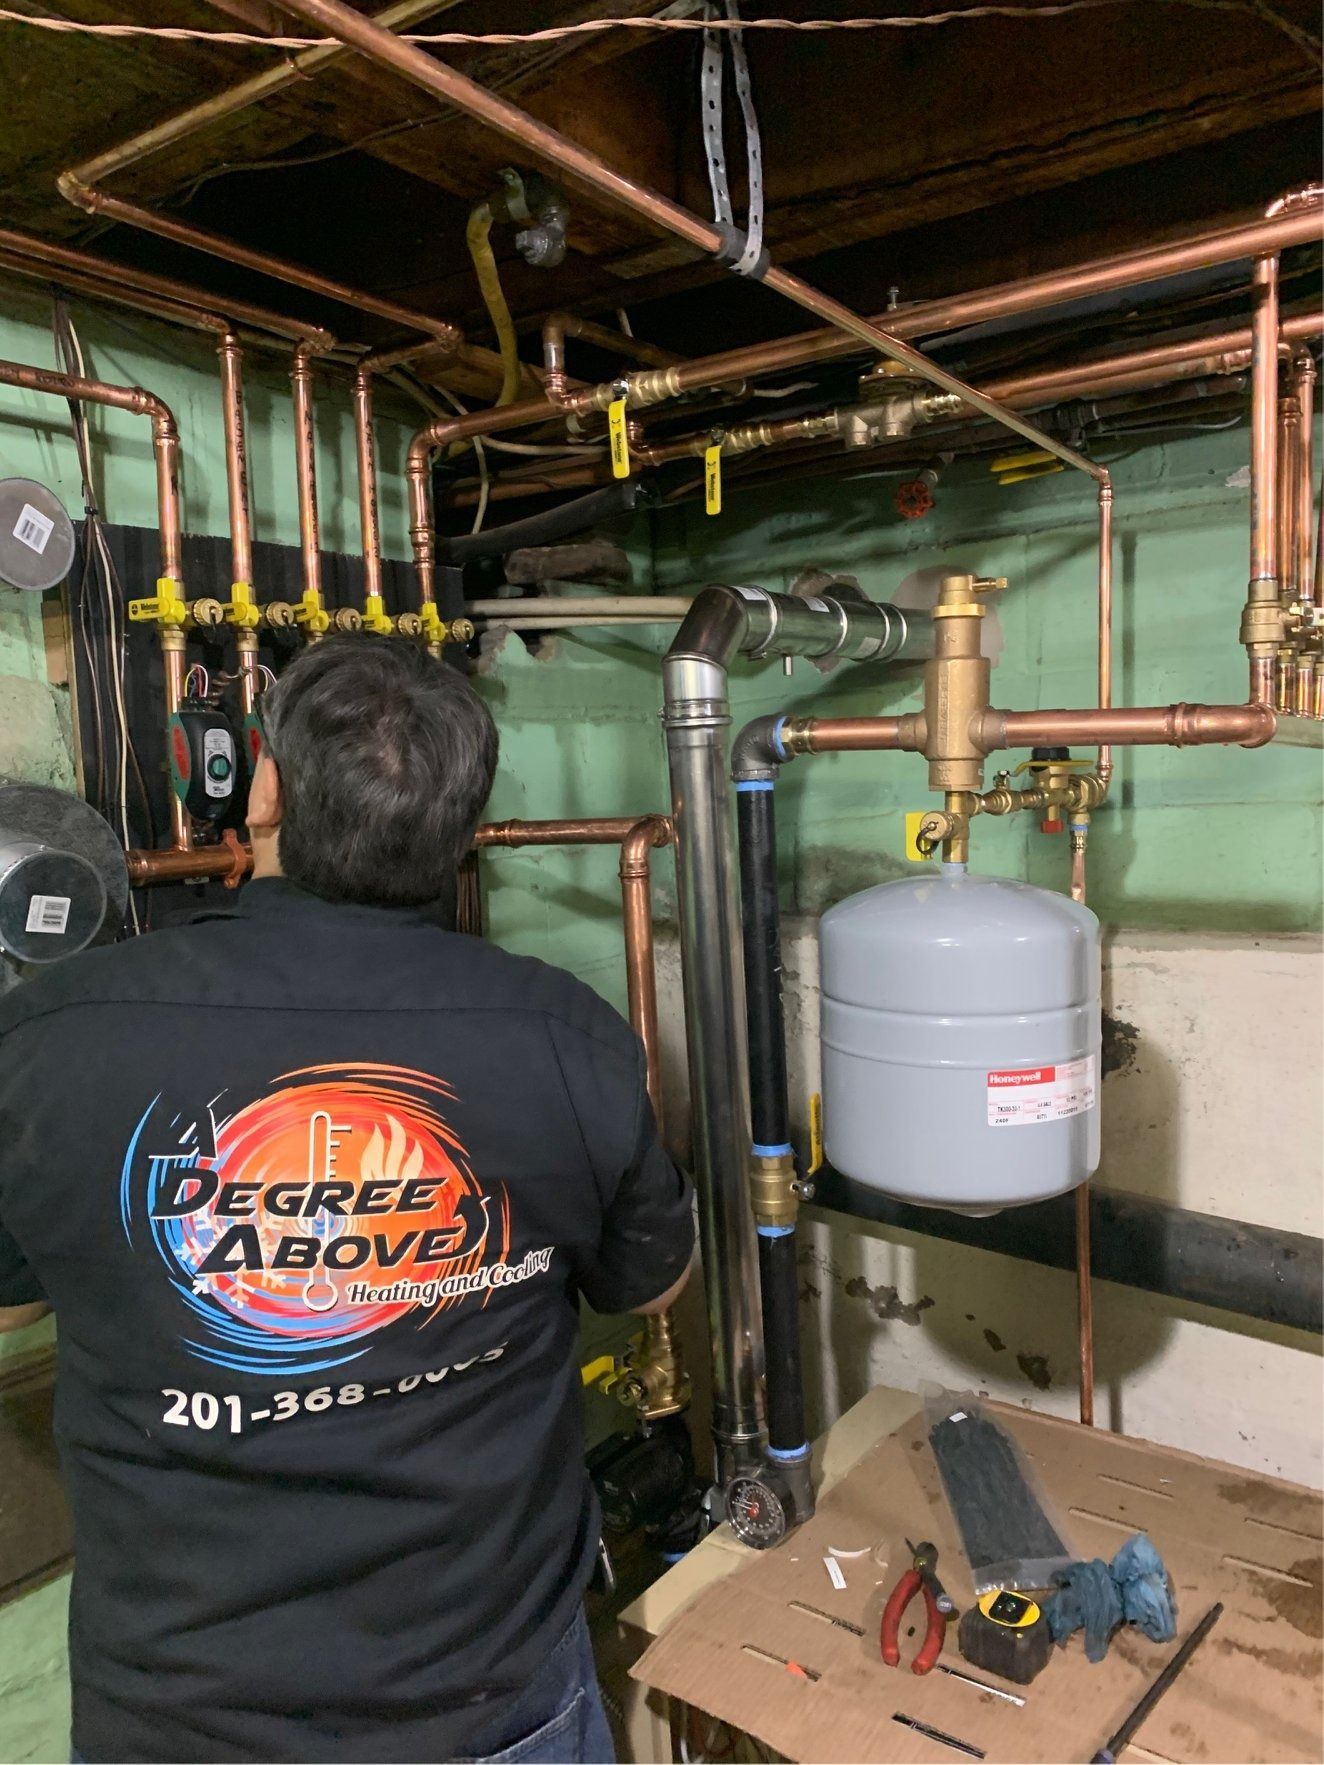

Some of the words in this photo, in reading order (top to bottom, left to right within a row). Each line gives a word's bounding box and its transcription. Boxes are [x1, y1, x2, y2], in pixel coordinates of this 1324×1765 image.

[989, 1071, 1041, 1085] Honeywell
[150, 1167, 448, 1220] DEGREE
[197, 1223, 464, 1275] ABOVE
[349, 1280, 439, 1307] Heating
[439, 1267, 487, 1296] and
[489, 1247, 555, 1286] Cooling
